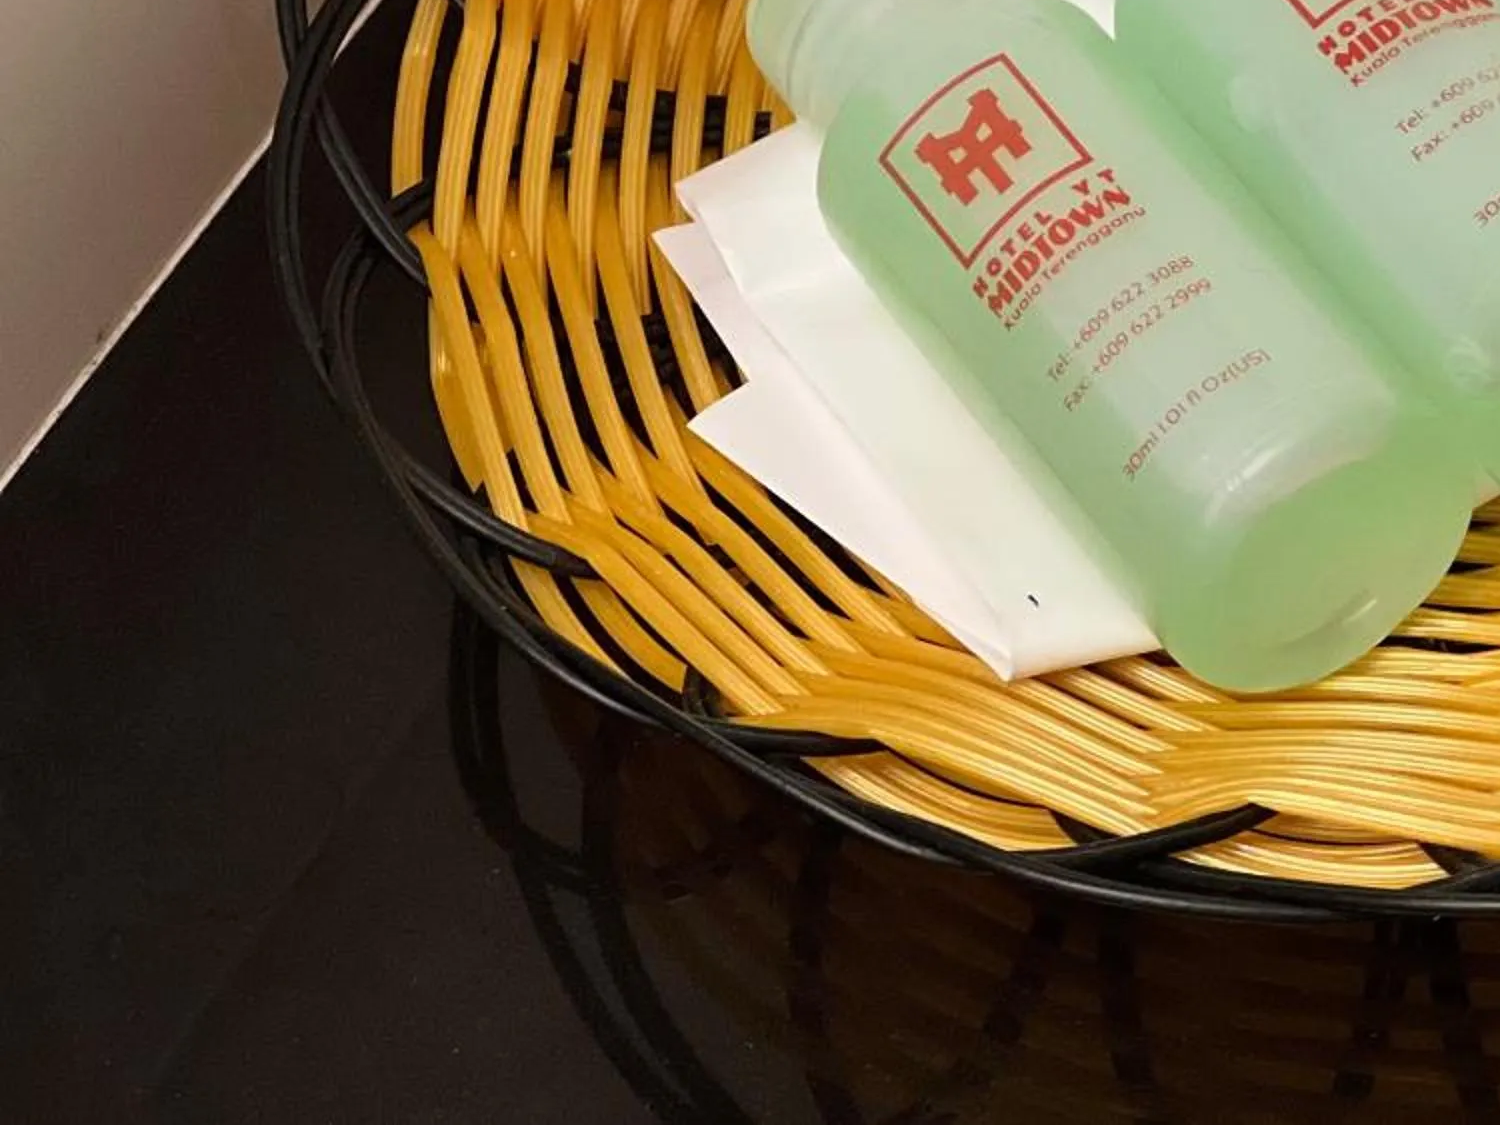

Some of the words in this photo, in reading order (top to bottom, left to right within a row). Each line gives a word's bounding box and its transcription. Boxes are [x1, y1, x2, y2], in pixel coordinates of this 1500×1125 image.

[1350, 46, 1400, 87] Kuala
[1395, 107, 1428, 134] Tel:
[1410, 129, 1450, 162] Fax:
[973, 210, 1053, 298] HOTEL
[988, 185, 1130, 318] MIDTOWN
[1004, 282, 1041, 332] Kuala
[1042, 206, 1146, 281] Terengganu
[1047, 352, 1073, 382] Tel:
[1073, 308, 1110, 351] +609
[1111, 282, 1145, 313] 622
[1147, 255, 1194, 285] 3088
[1063, 378, 1093, 412] Fax:
[1092, 331, 1129, 375] +609
[1130, 304, 1164, 336] 622
[1165, 277, 1211, 309] 2999
[1123, 431, 1160, 482] 30ml
